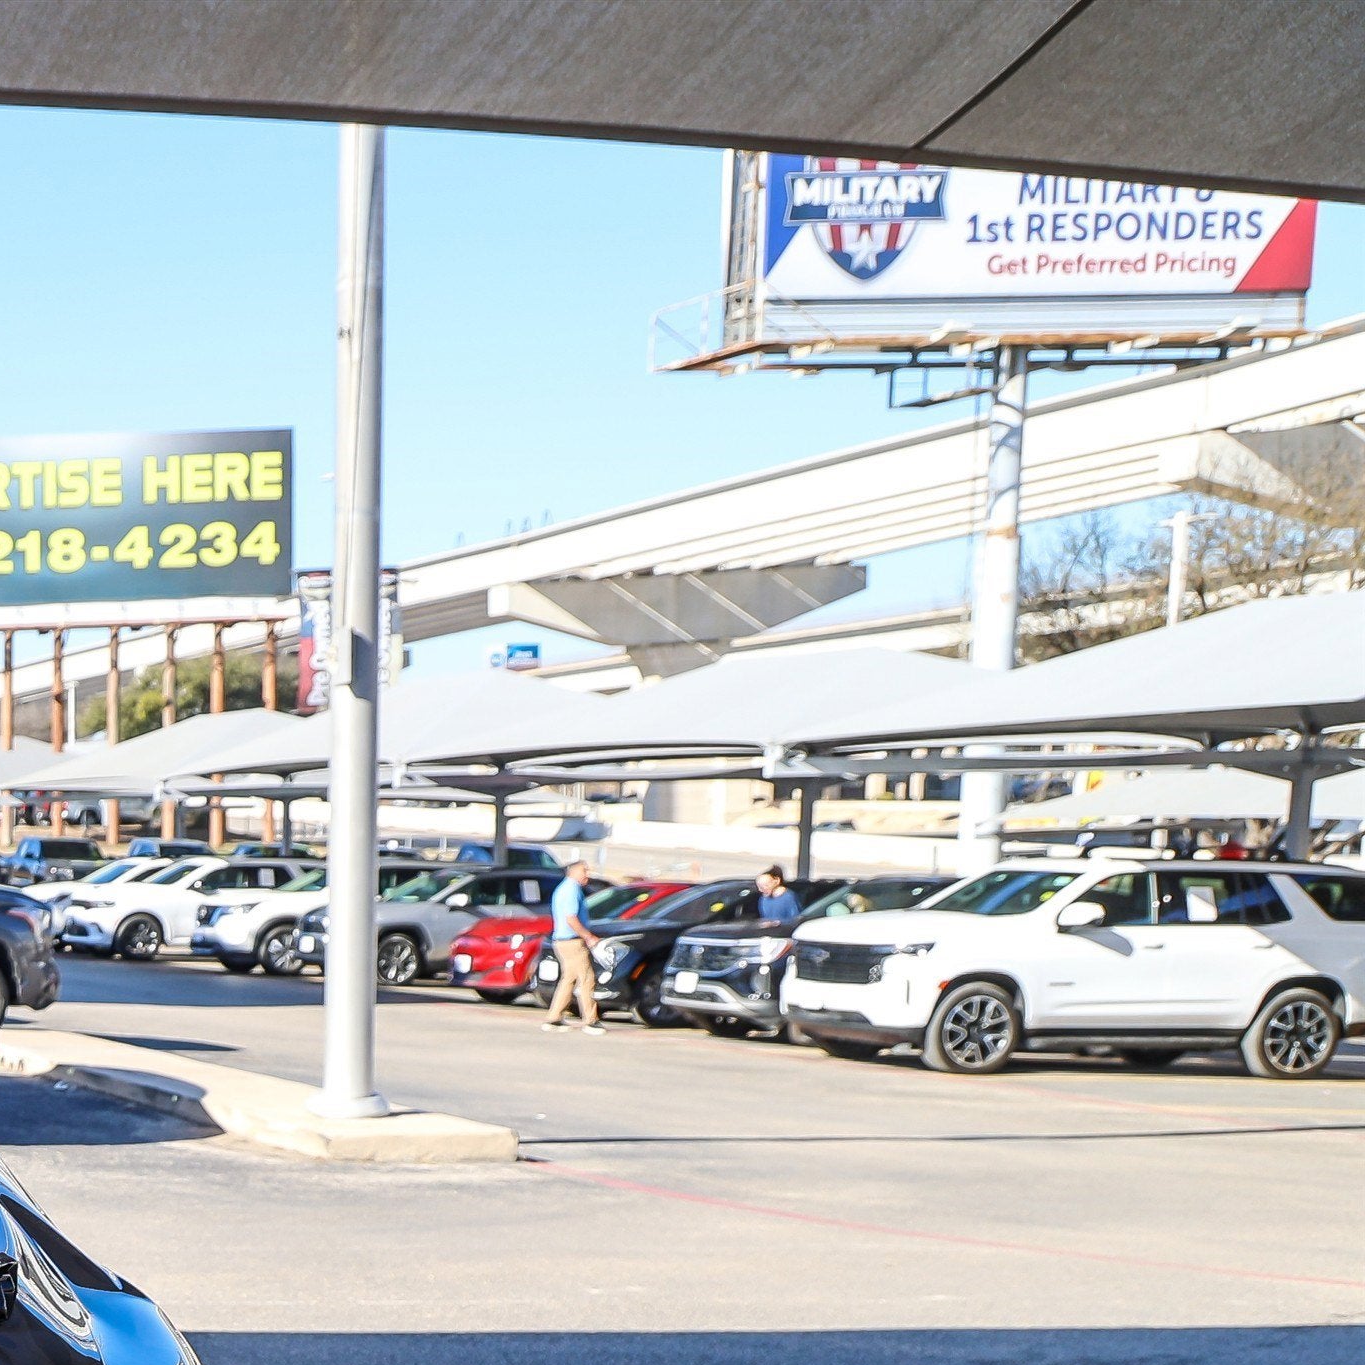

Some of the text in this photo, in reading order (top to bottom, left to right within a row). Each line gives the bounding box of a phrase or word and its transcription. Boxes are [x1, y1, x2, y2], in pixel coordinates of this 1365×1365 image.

[792, 174, 943, 207] MILITARY
[966, 210, 1264, 243] 1st RESPONDERS
[987, 251, 1237, 278] Get Preferred Pricing
[143, 451, 283, 504] HERE
